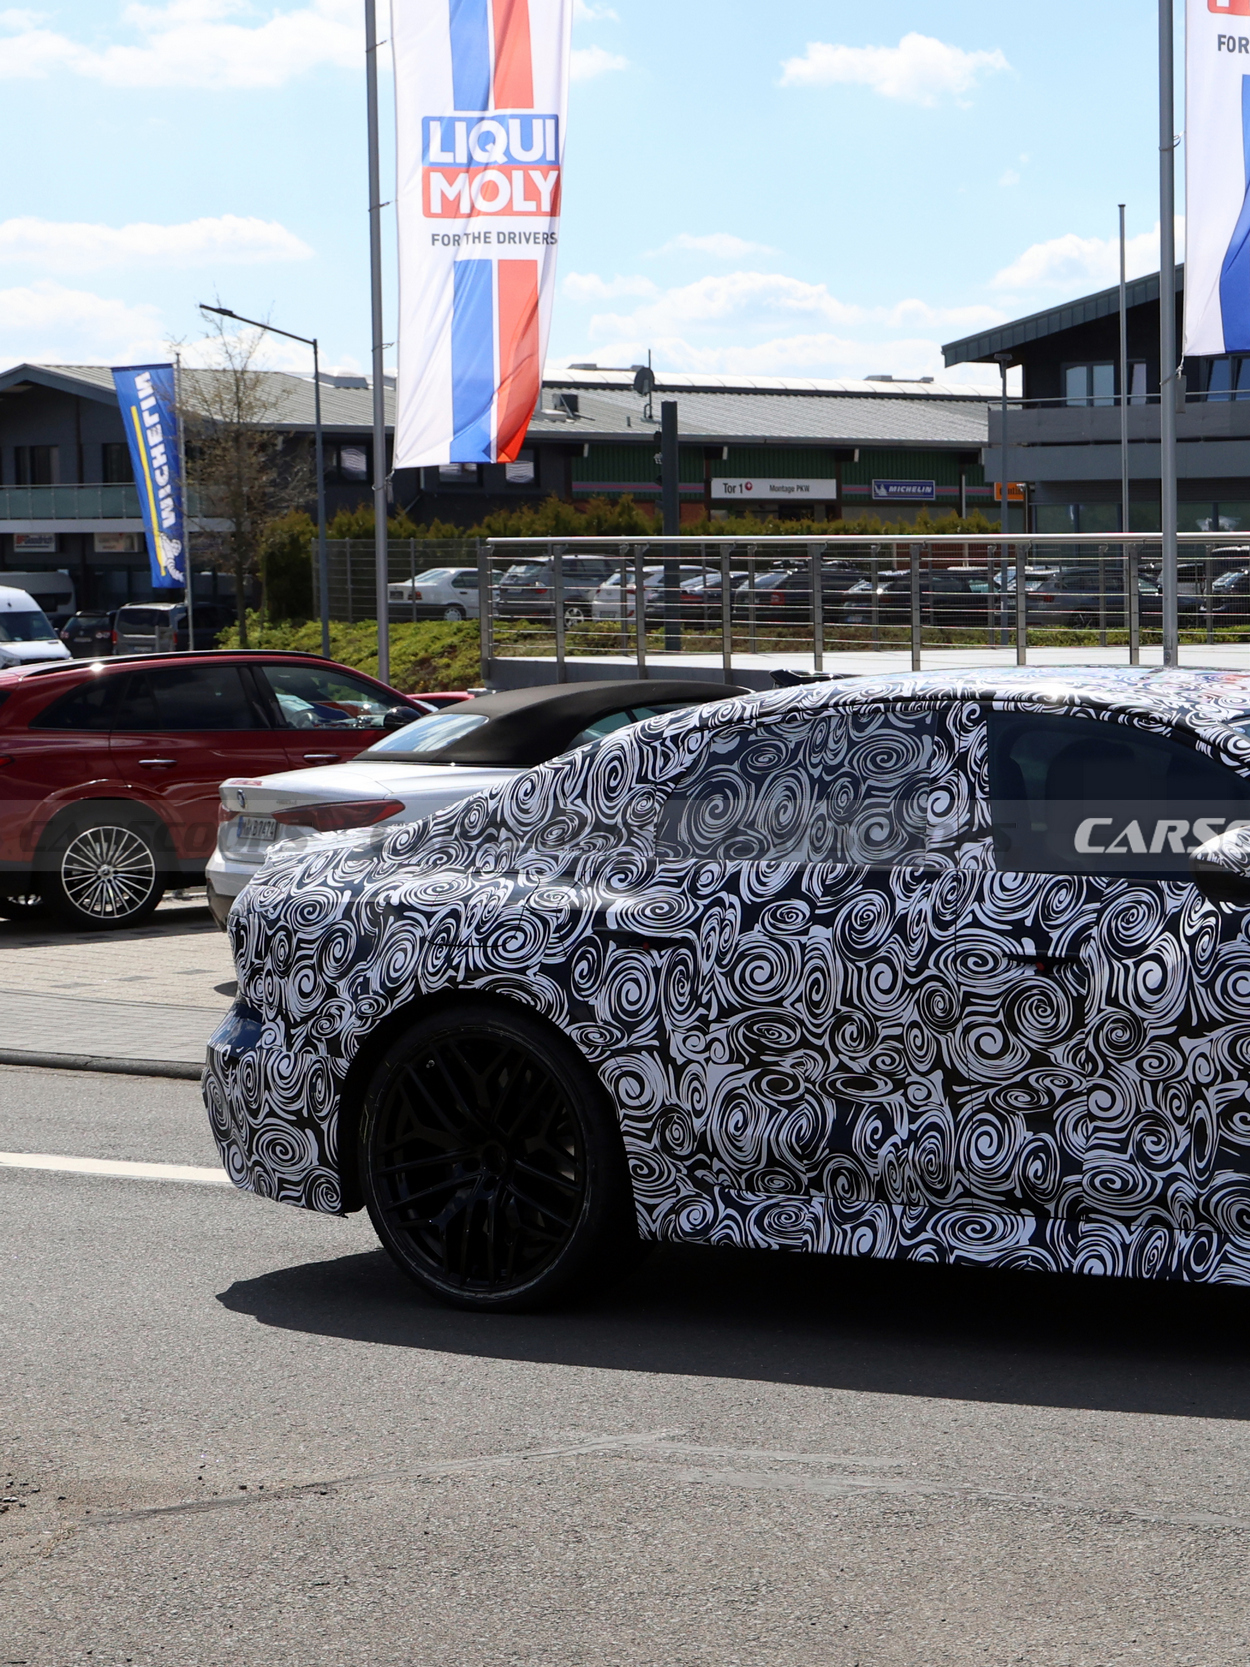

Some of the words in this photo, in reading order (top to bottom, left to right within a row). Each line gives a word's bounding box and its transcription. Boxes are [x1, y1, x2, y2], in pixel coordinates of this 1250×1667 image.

[1217, 34, 1250, 54] FOR
[429, 118, 556, 165] LIQUI
[429, 169, 560, 214] MOLY
[431, 233, 461, 247] FOR
[463, 231, 492, 245] THE
[496, 231, 558, 245] DRIVERS
[134, 371, 176, 529] MICHELIN
[722, 482, 737, 494] Tor
[738, 483, 744, 494] 1
[769, 484, 796, 494] Montage
[796, 484, 811, 493] PKW
[888, 485, 933, 493] MICHELIN
